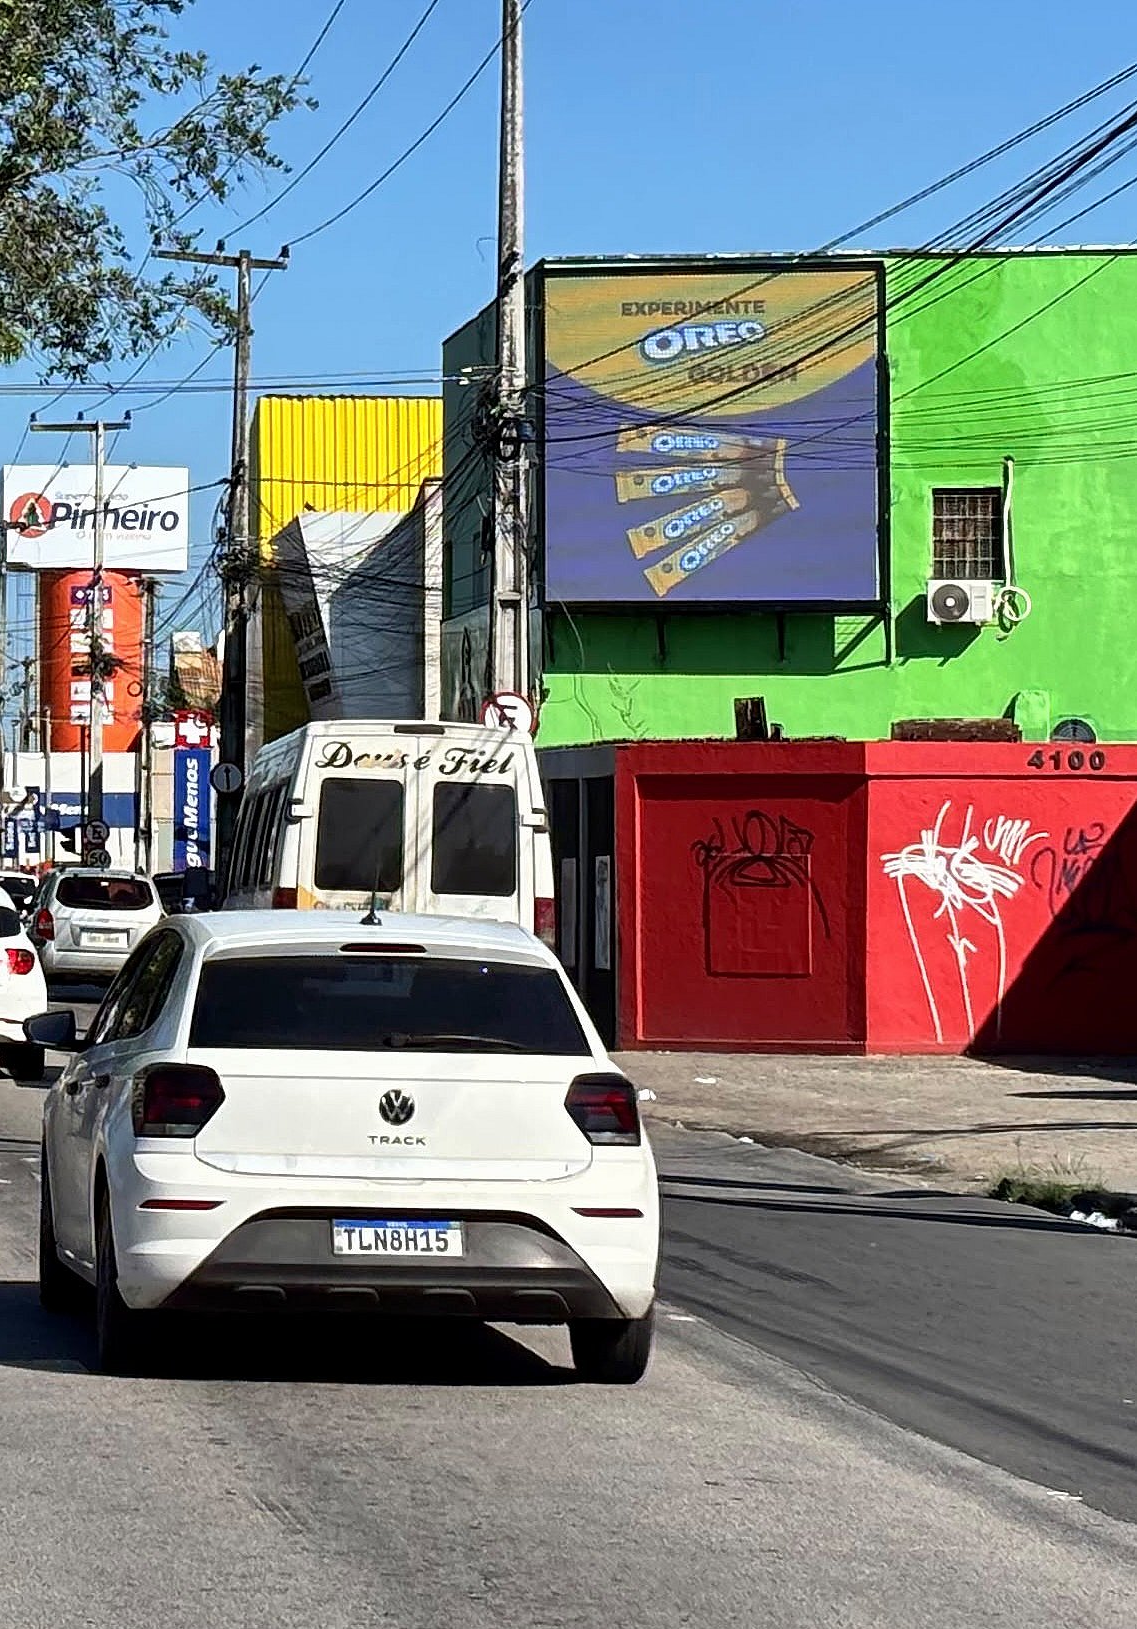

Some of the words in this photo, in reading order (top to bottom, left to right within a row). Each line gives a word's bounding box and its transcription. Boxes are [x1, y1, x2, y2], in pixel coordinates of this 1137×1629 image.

[621, 300, 766, 316] EXPERIMENTE
[642, 319, 766, 360] OREO
[51, 502, 180, 532] Pinheiro
[315, 741, 410, 769] Deus
[413, 749, 432, 770] é
[438, 747, 515, 776] Fiel
[1027, 749, 1105, 771] 4100
[367, 1135, 427, 1146] TRACK
[343, 1229, 449, 1252] TLN8H15
